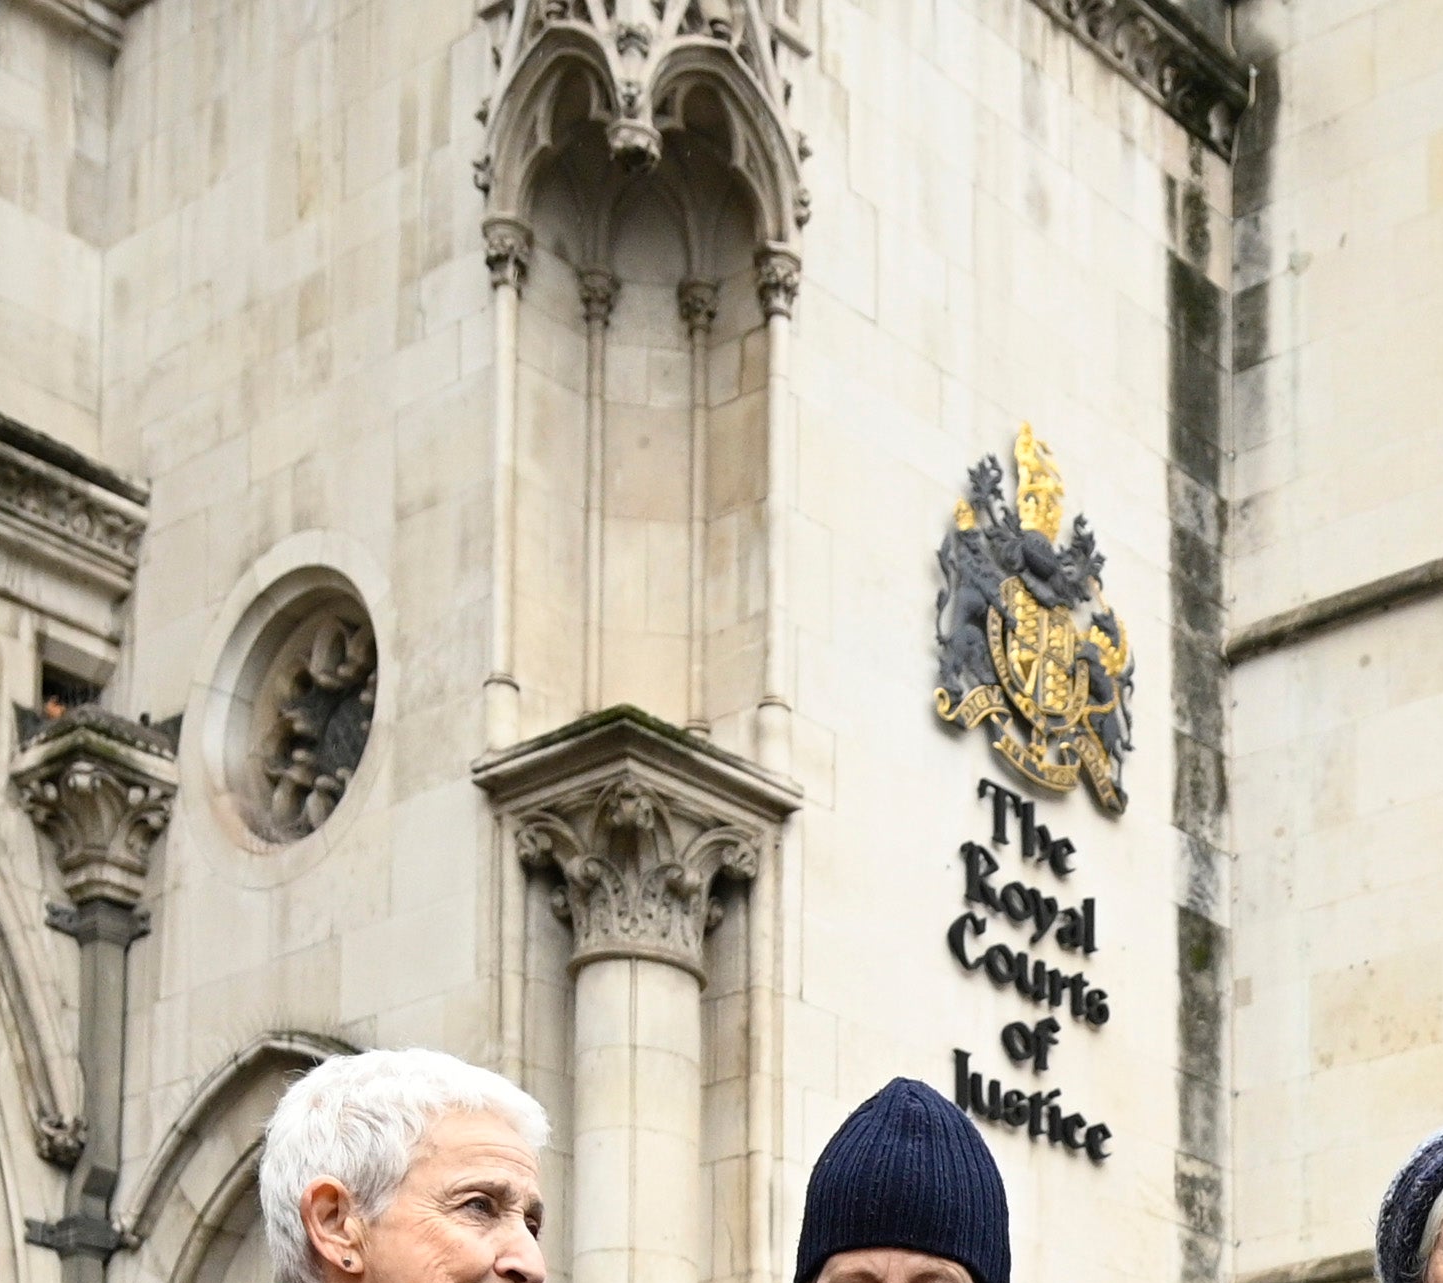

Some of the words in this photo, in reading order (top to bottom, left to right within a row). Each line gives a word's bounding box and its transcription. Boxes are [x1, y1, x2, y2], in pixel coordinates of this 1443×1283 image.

[978, 778, 1075, 874] The
[961, 840, 1096, 954] Royal
[947, 912, 1109, 1027] Courts
[1002, 1016, 1059, 1072] of
[953, 1049, 1111, 1162] Justice
